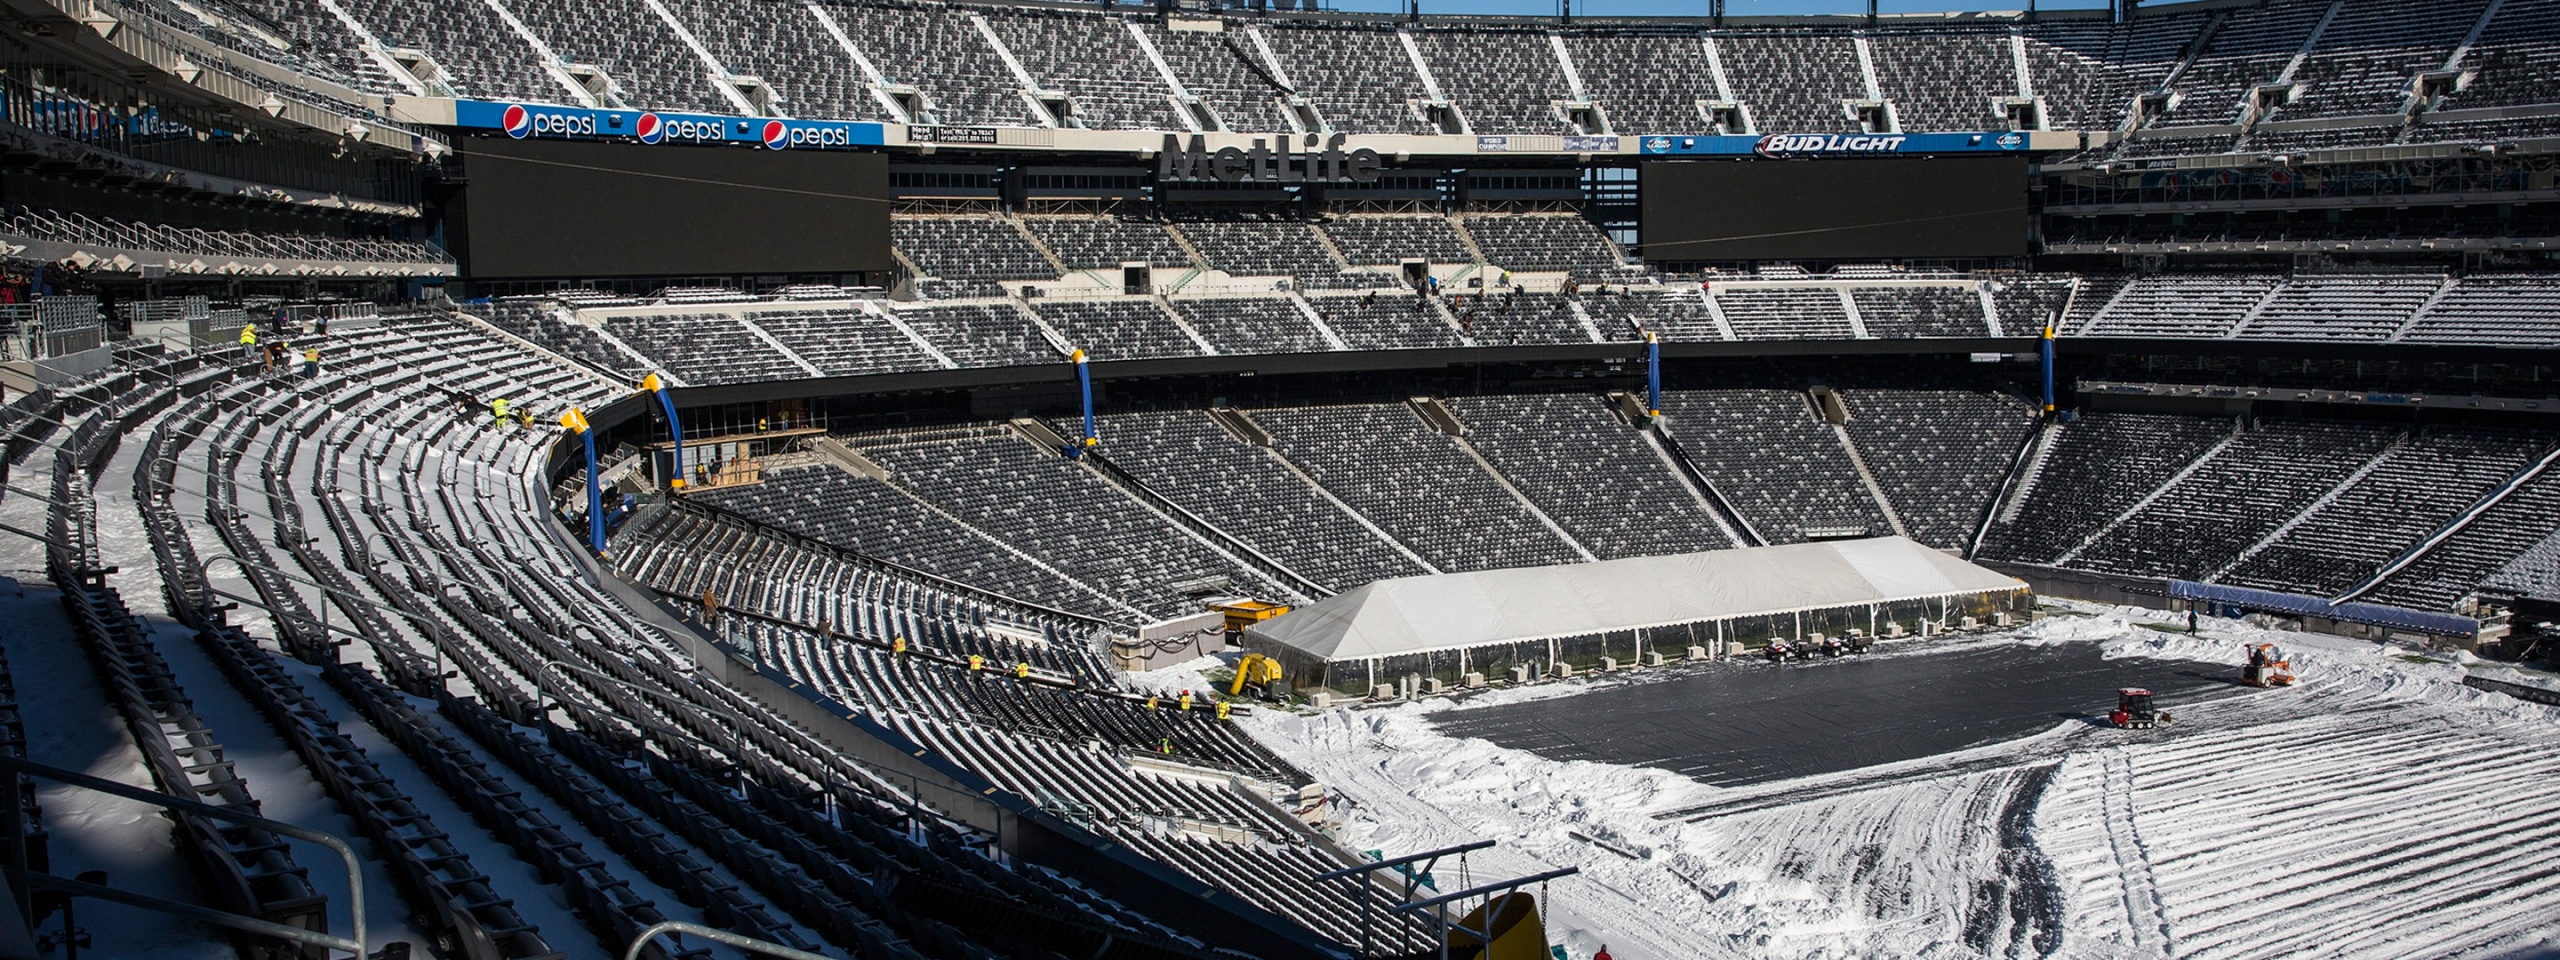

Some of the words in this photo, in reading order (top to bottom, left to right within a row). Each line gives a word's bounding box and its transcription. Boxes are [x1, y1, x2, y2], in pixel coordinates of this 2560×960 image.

[534, 113, 596, 139] pepsi
[665, 119, 725, 144] pepsi
[790, 125, 850, 149] pepsi
[912, 133, 933, 142] Help?
[1765, 135, 1826, 151] BUD
[1824, 134, 1906, 151] LIGHT
[1158, 132, 1382, 183] MetLife
